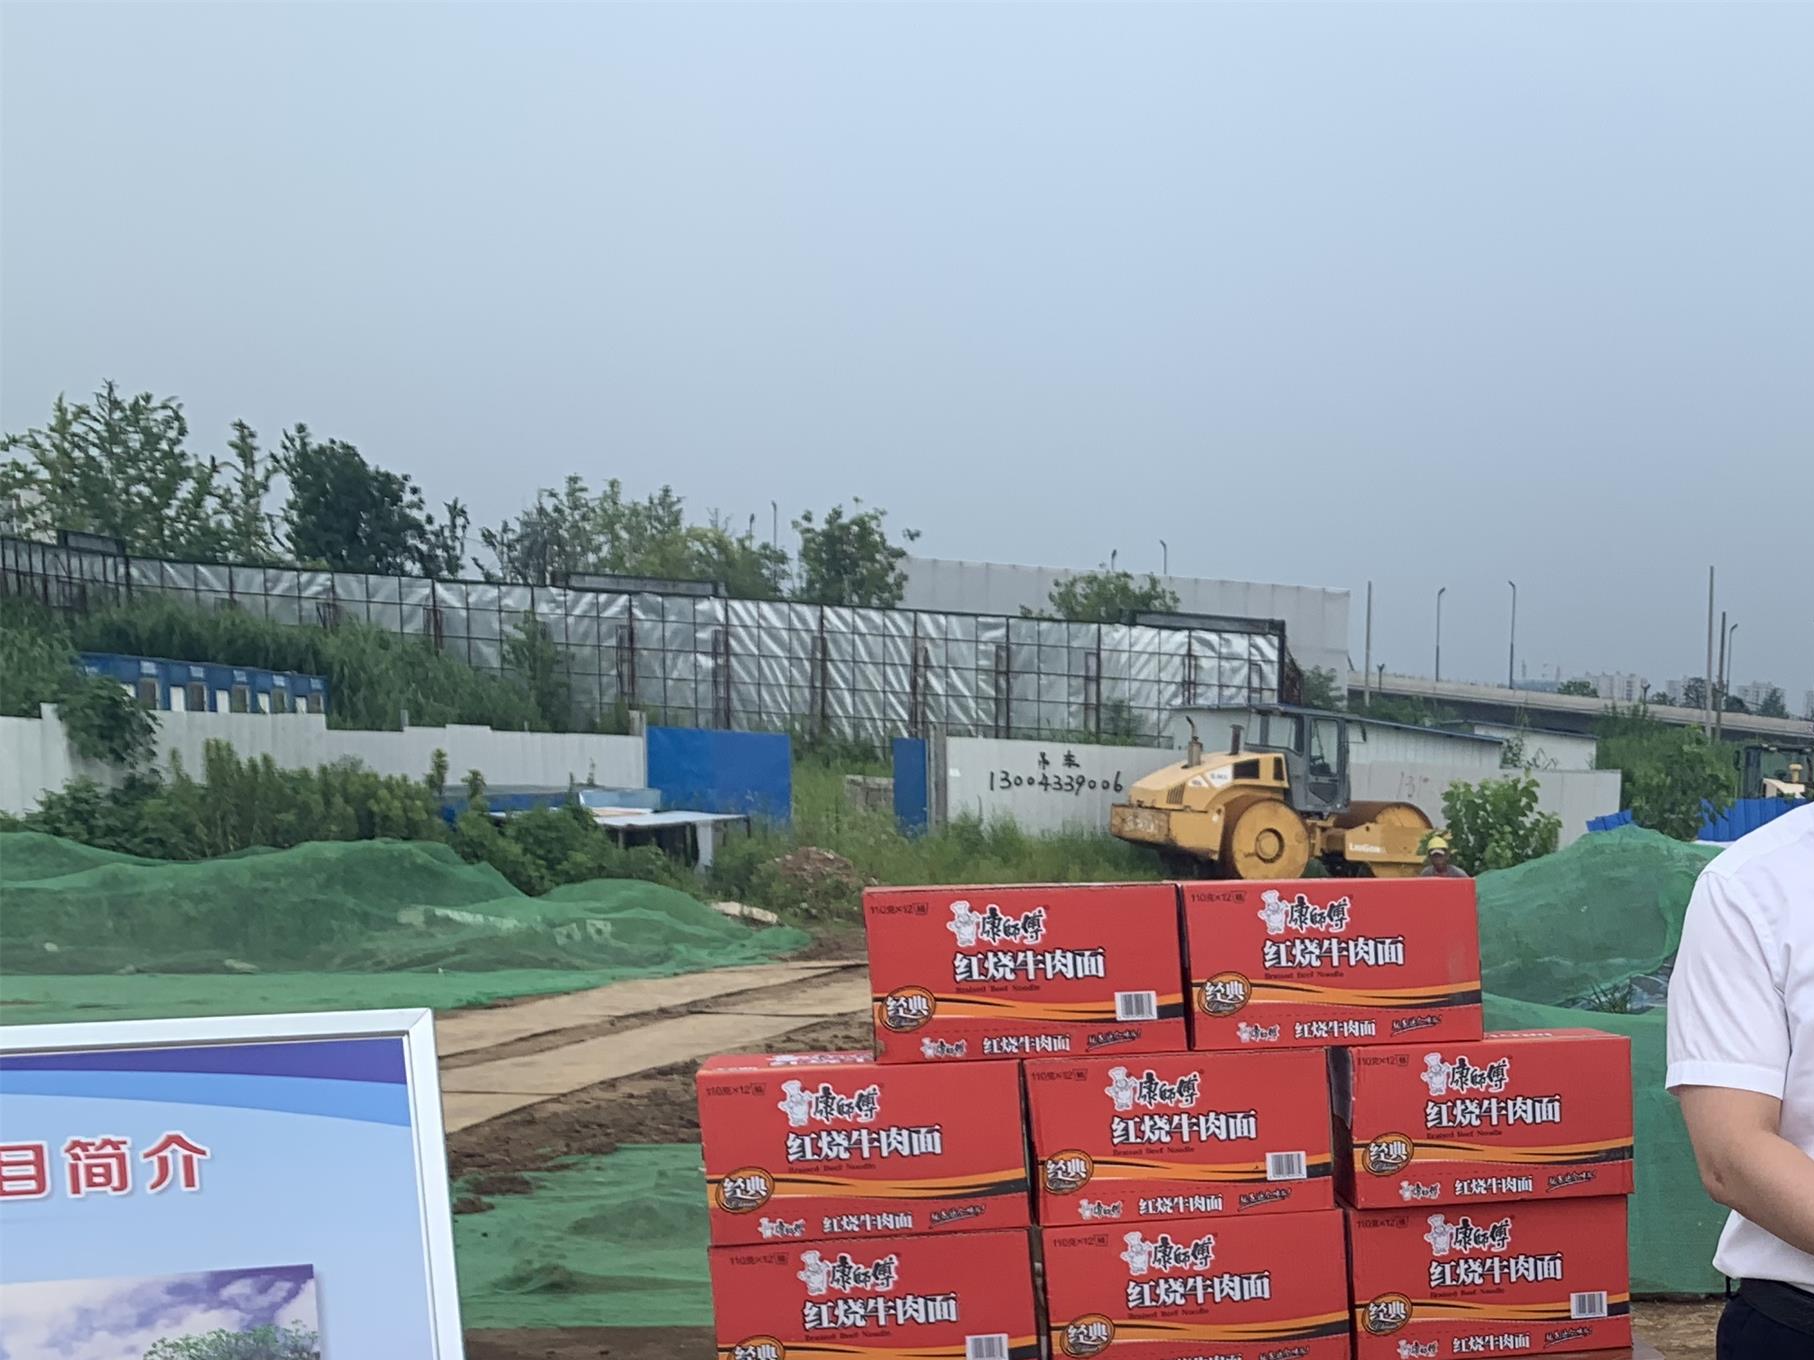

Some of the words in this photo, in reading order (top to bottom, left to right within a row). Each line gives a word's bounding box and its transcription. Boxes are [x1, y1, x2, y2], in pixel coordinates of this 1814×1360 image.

[990, 770, 1123, 795] 13004339006
[981, 905, 1046, 943] 康師傅
[1288, 895, 1350, 931] 康師傅
[953, 947, 1105, 983] 红烧牛肉面
[1262, 936, 1405, 969] 红烧牛肉面
[887, 995, 929, 1016] 经典
[1204, 981, 1245, 1002] 经典
[982, 1035, 1071, 1054] 红烧牛肉面
[1294, 1020, 1376, 1038] 红烧牛肉面
[1137, 1070, 1199, 1108] 康師傅
[1450, 1056, 1510, 1093] 康師傅
[813, 1084, 879, 1121] 康師傅
[1426, 1095, 1560, 1129] 红烧牛肉面
[786, 1125, 942, 1163] 红烧牛肉面
[1112, 1111, 1257, 1146] 红烧牛肉面
[0, 1131, 210, 1199] 目简介
[1047, 1158, 1087, 1179] 经典
[1370, 1141, 1407, 1162] 经典
[723, 1176, 767, 1198] 经典
[1455, 1177, 1532, 1195] 红烧牛肉面
[823, 1212, 913, 1232] 红烧牛肉面
[1139, 1195, 1222, 1215] 红烧牛肉面
[1453, 1217, 1511, 1251] 康師傅
[1151, 1234, 1215, 1270] 康師傅
[830, 1254, 897, 1291] 康師傅
[1429, 1252, 1562, 1287] 红烧牛肉面
[1126, 1271, 1271, 1308] 红烧牛肉面
[803, 1293, 958, 1330] 红烧牛肉面
[1369, 1303, 1406, 1322] 经典
[1067, 1322, 1108, 1343] 经典
[1453, 1335, 1530, 1352] 红烧牛肉面
